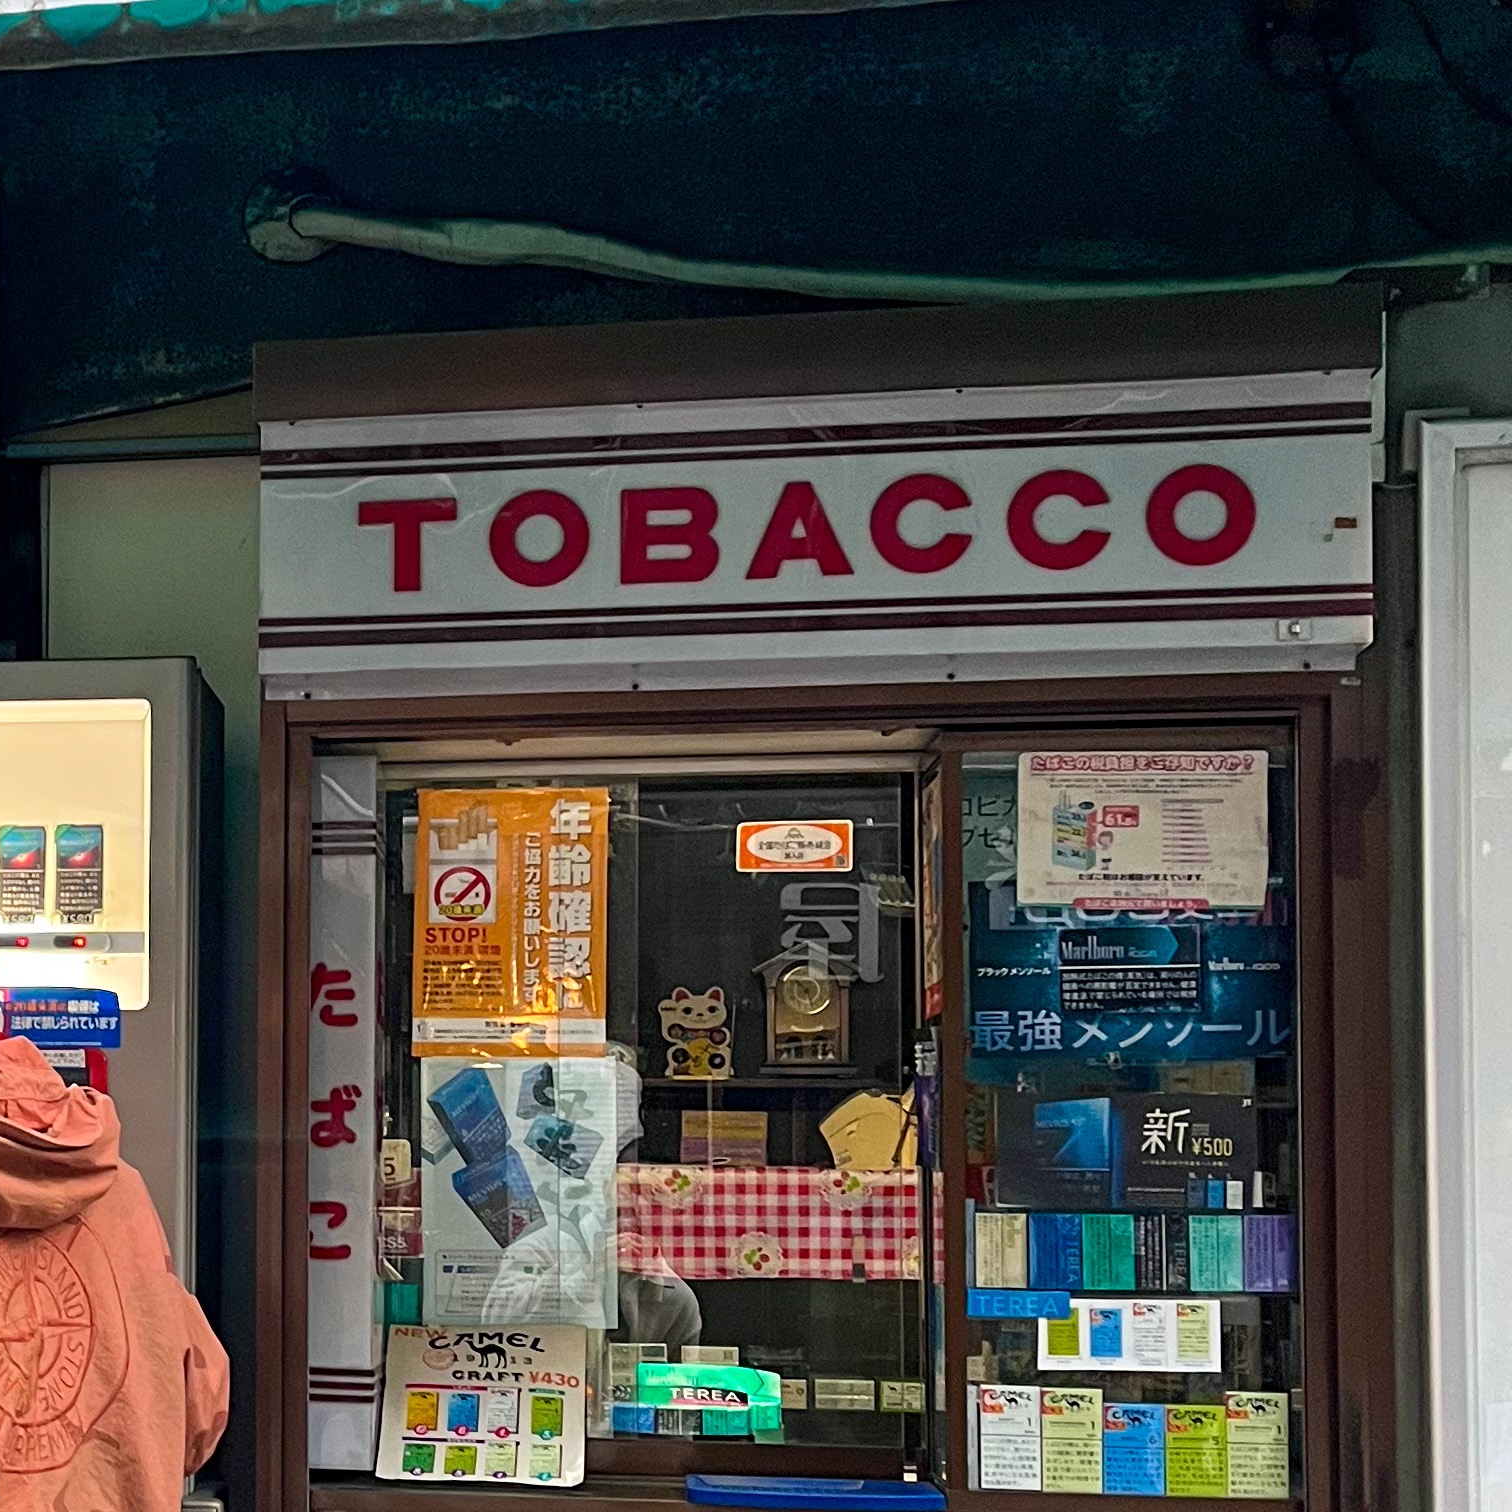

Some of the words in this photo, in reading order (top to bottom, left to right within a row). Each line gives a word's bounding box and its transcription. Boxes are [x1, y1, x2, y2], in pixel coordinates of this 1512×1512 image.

[357, 463, 1256, 592] TOBACCO
[425, 927, 487, 944] STOP!
[1061, 935, 1125, 960] Marlboro
[970, 1008, 1290, 1052] 最強メンソール
[1141, 1107, 1191, 1155] 新
[1192, 1137, 1233, 1157] ¥500
[976, 1296, 1060, 1316] TEREA
[428, 1331, 546, 1353] CAMEL
[451, 1369, 525, 1383] CRAFT
[529, 1370, 580, 1389] ¥430
